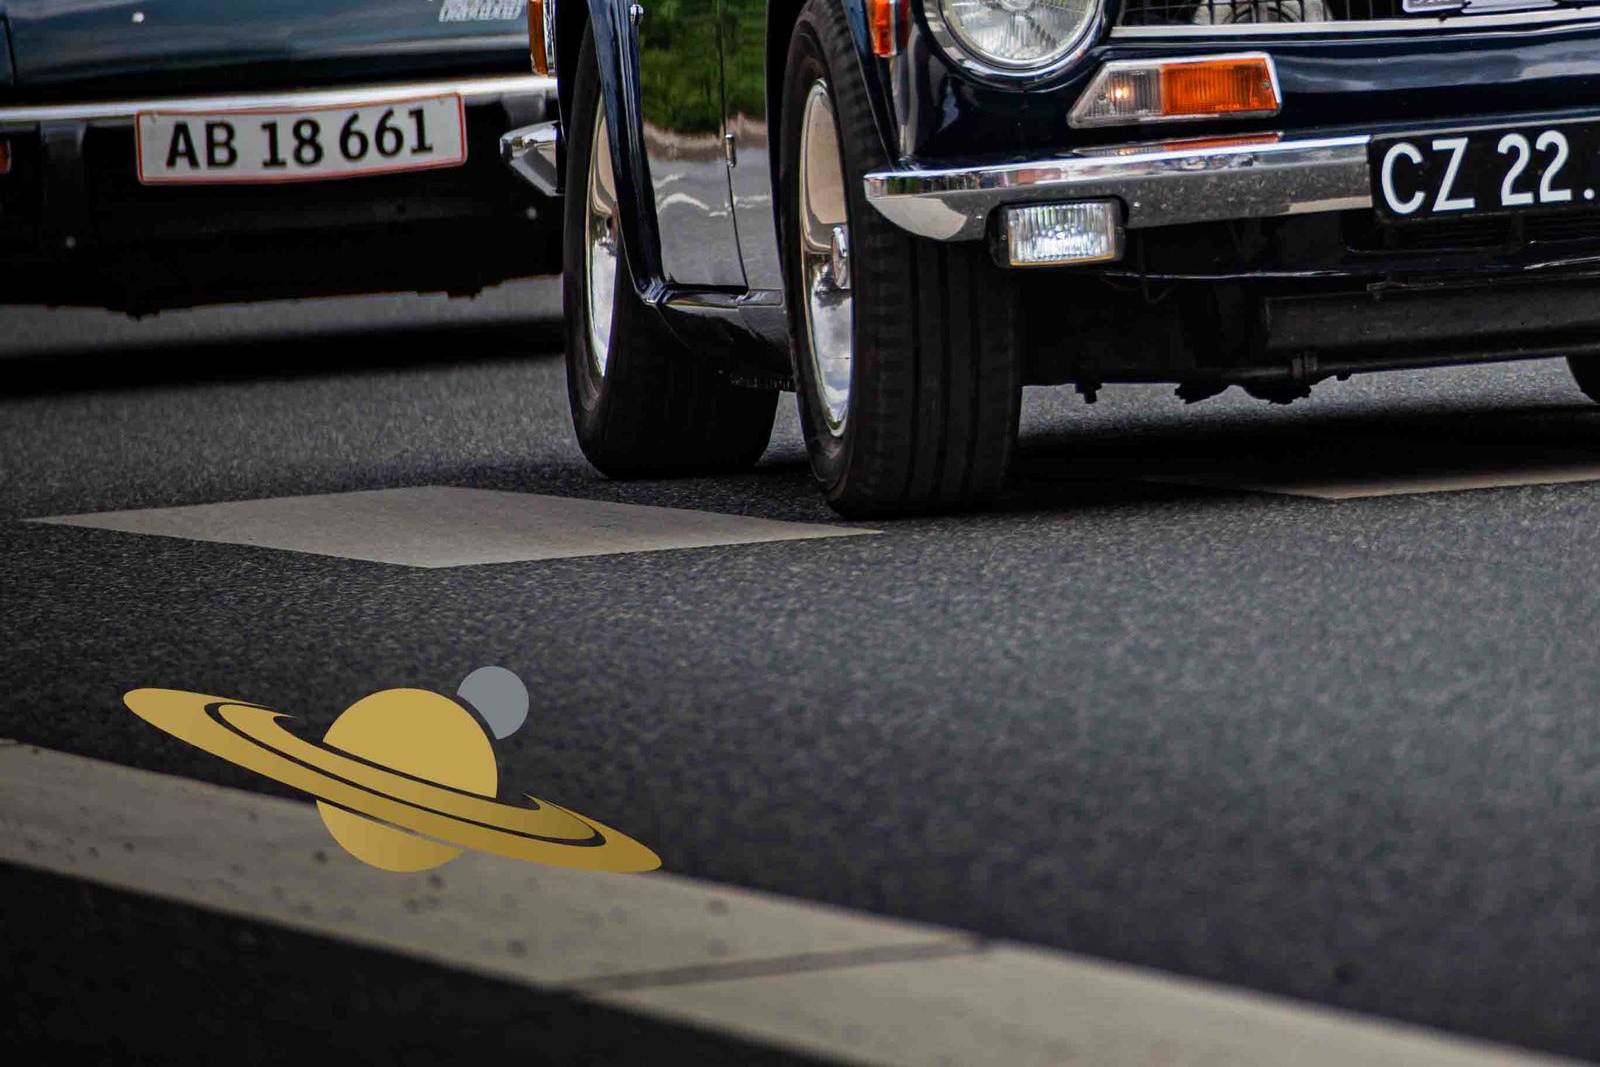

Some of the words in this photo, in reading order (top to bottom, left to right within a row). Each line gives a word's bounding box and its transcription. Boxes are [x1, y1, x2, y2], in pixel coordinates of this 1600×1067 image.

[165, 120, 239, 170] AB
[260, 117, 325, 168] 18
[338, 106, 434, 163] 661
[1381, 136, 1476, 216] CZ
